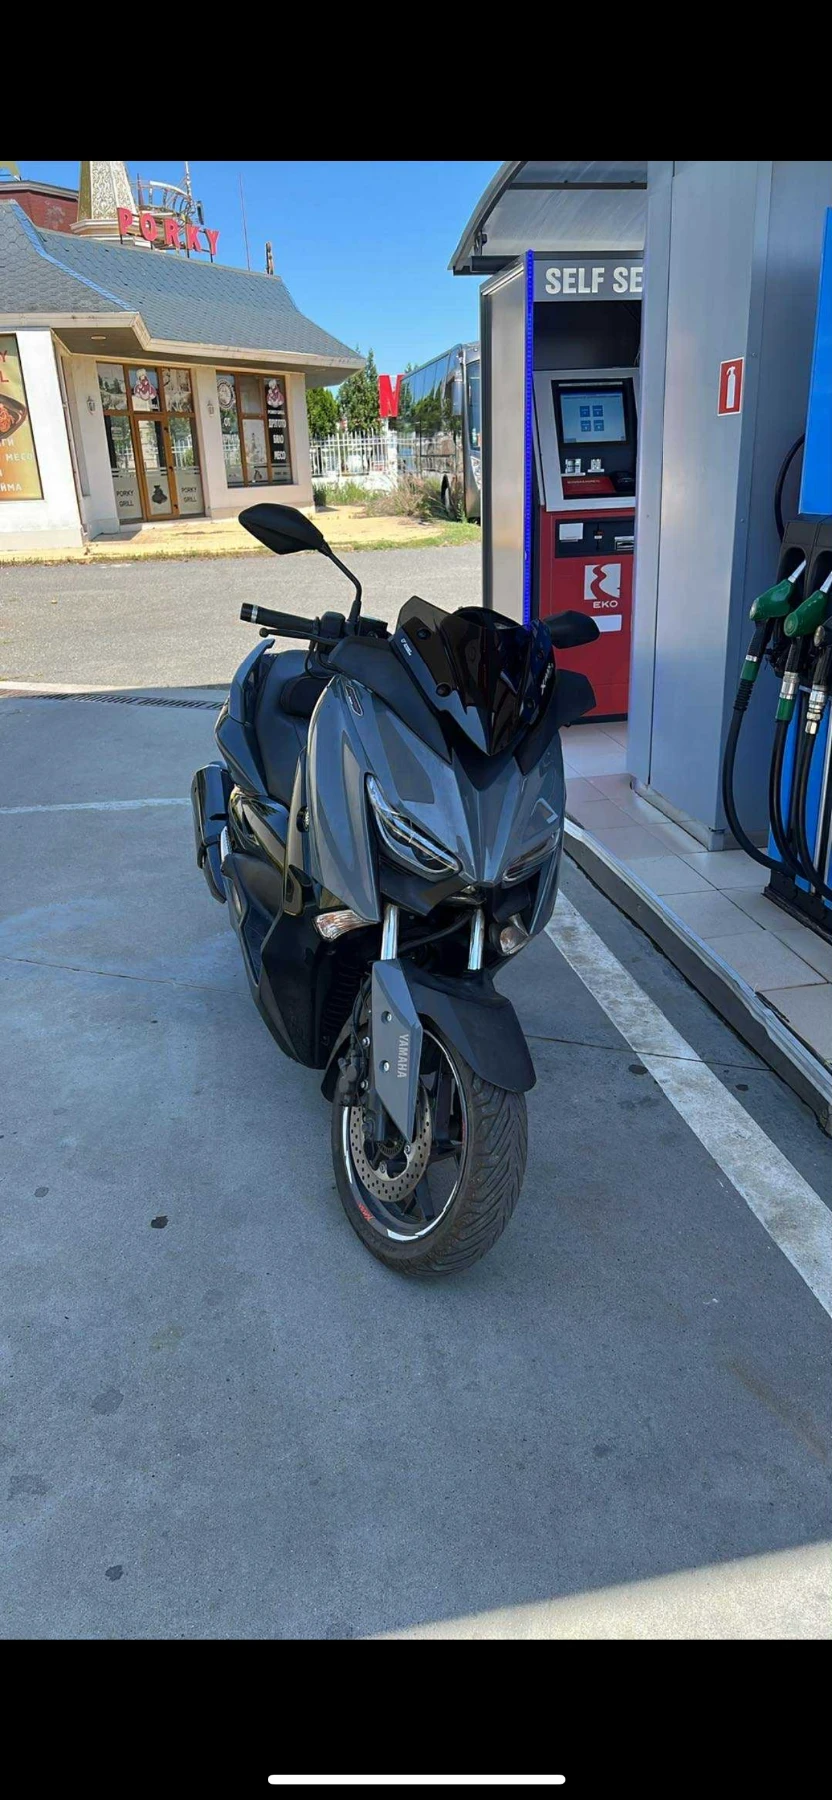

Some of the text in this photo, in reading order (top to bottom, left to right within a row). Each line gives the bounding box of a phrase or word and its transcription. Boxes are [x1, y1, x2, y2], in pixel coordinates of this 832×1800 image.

[117, 207, 219, 255] PORKY
[545, 267, 605, 294] SELF
[592, 600, 619, 609] EKO
[397, 1034, 409, 1078] YAMAHA
